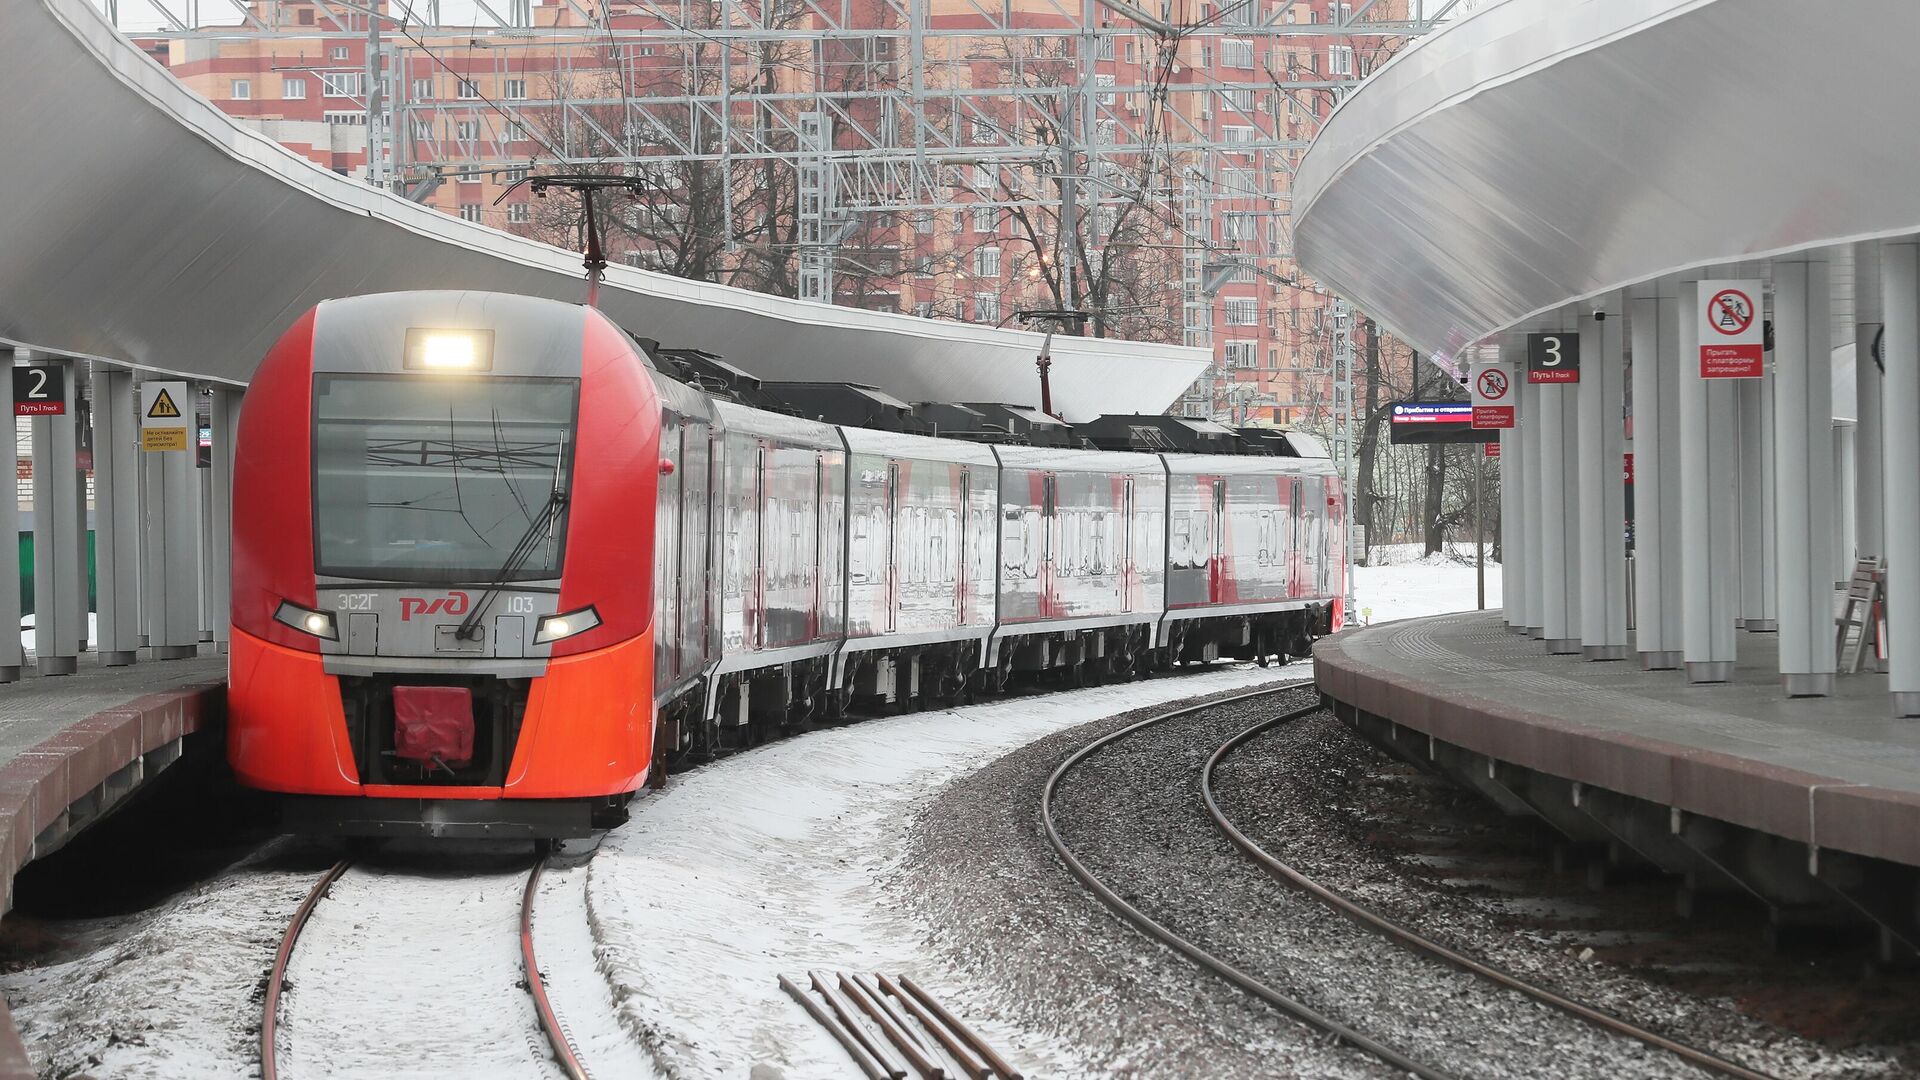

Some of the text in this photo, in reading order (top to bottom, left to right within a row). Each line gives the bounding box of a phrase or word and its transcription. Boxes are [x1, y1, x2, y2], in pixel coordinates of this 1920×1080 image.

[1543, 336, 1561, 367] 3
[1706, 349, 1737, 357] Прыгать
[1712, 357, 1755, 365] платформы
[1533, 371, 1551, 380] Путь
[28, 369, 47, 398] 2
[20, 404, 38, 412] Путь
[1404, 406, 1434, 414] Прибытие
[338, 593, 379, 611] ЭС2Г
[507, 596, 534, 613] 103
